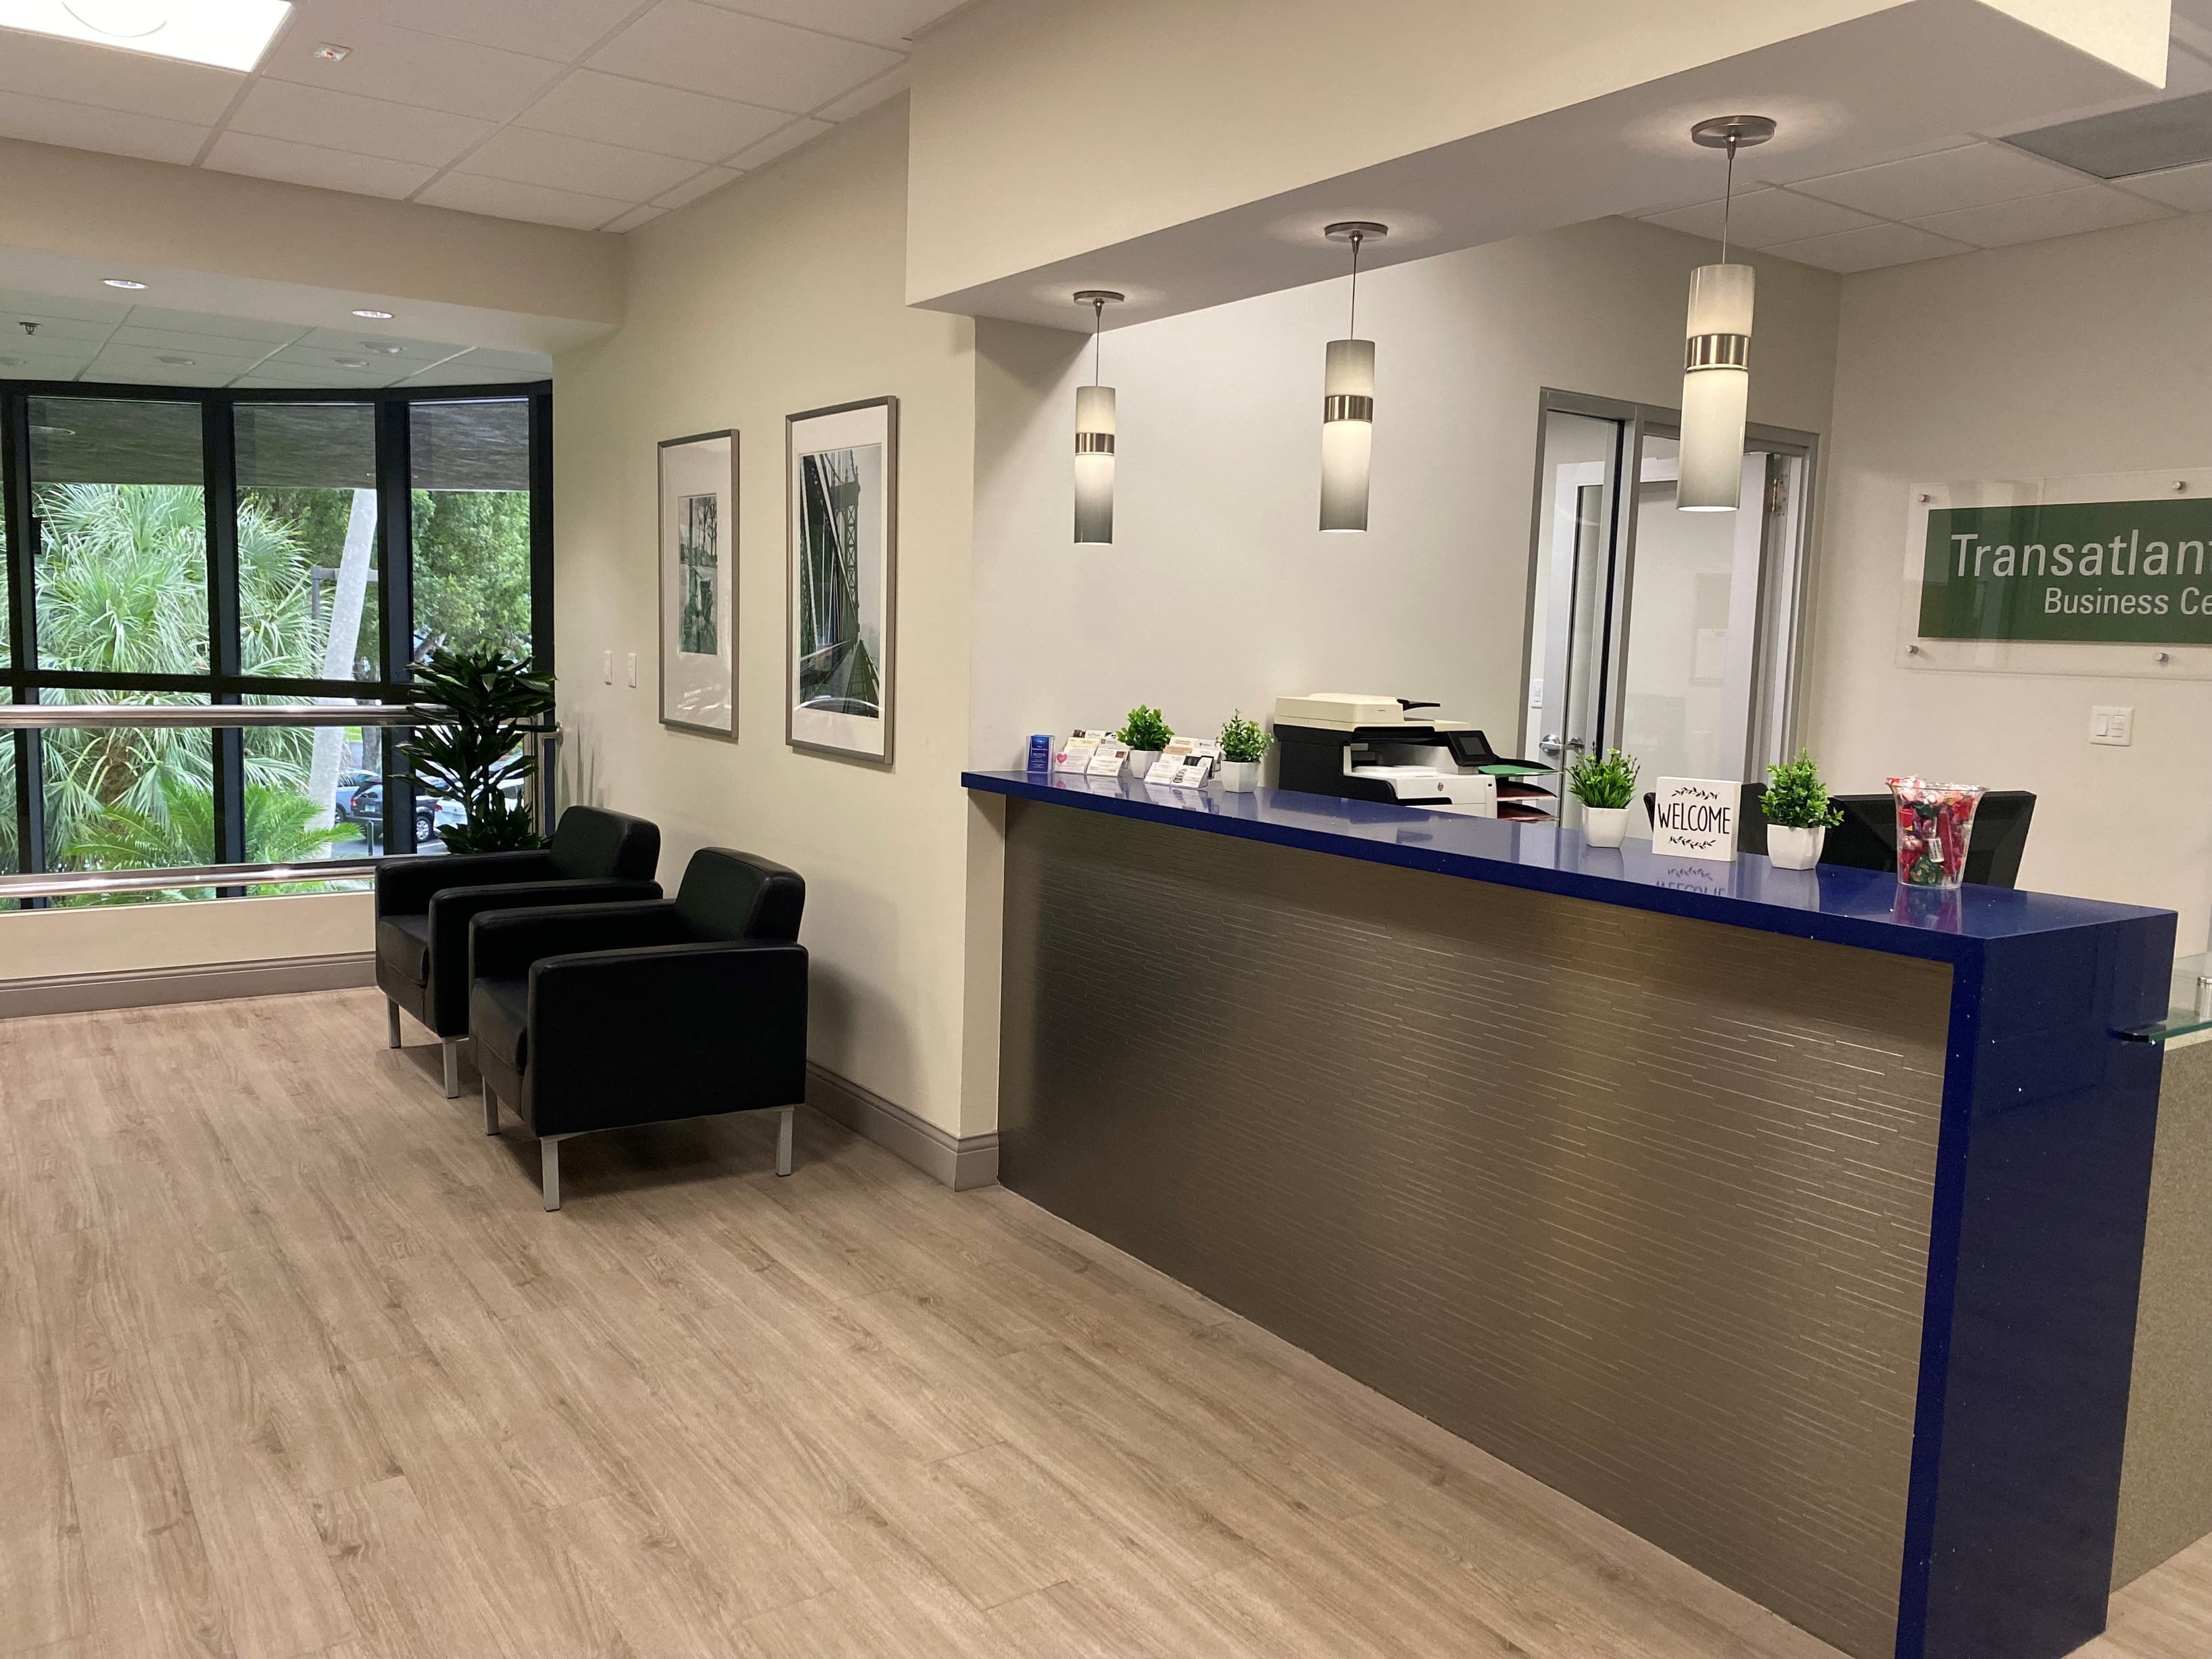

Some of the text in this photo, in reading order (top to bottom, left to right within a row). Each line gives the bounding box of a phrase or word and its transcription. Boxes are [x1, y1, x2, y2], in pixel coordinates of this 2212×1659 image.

[1951, 529, 2212, 577] Transatlan
[2044, 587, 2169, 615] Business
[1658, 802, 1731, 834] WELCOME
